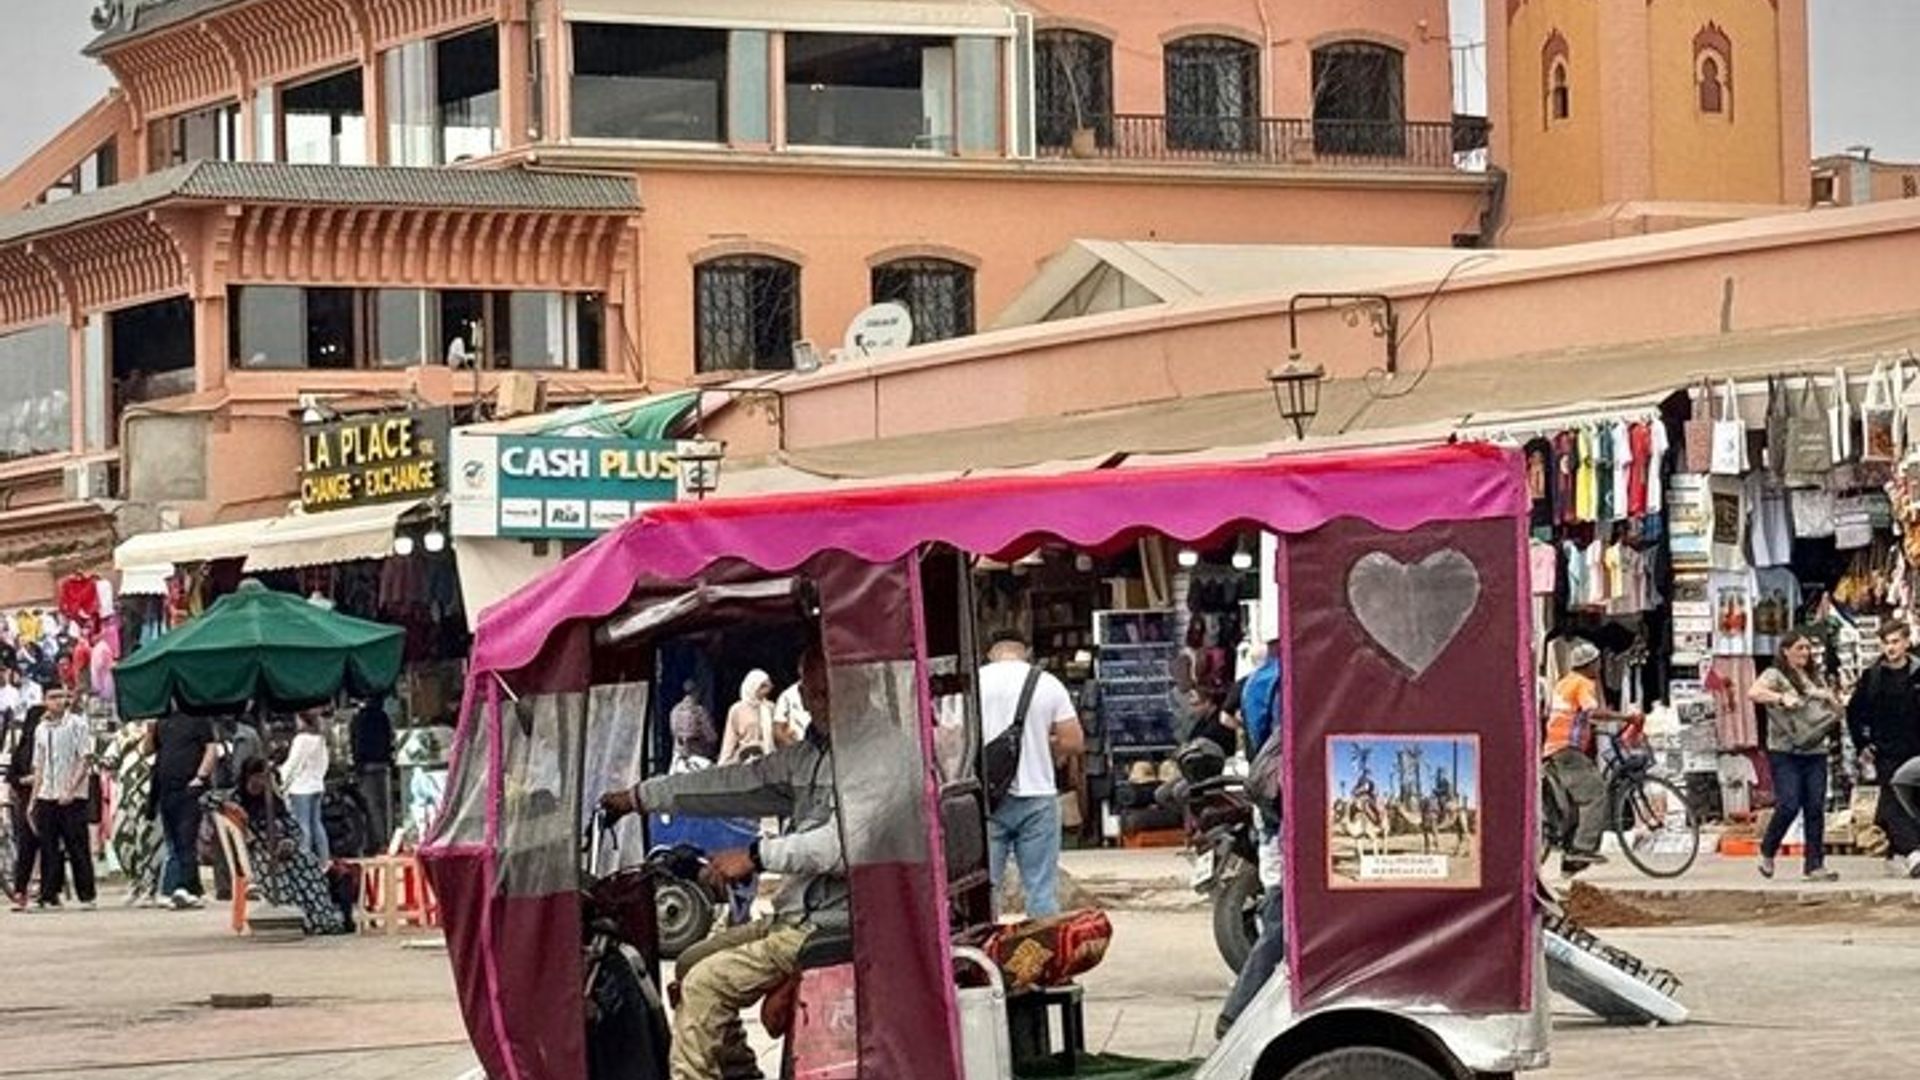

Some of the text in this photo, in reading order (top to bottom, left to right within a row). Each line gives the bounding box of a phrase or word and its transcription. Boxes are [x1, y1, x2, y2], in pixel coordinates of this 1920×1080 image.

[303, 417, 412, 471] LA PLACE
[501, 446, 681, 480] CASH PLUS
[301, 460, 434, 503] CHANGE EXCHANGE
[551, 504, 580, 522] Ria
